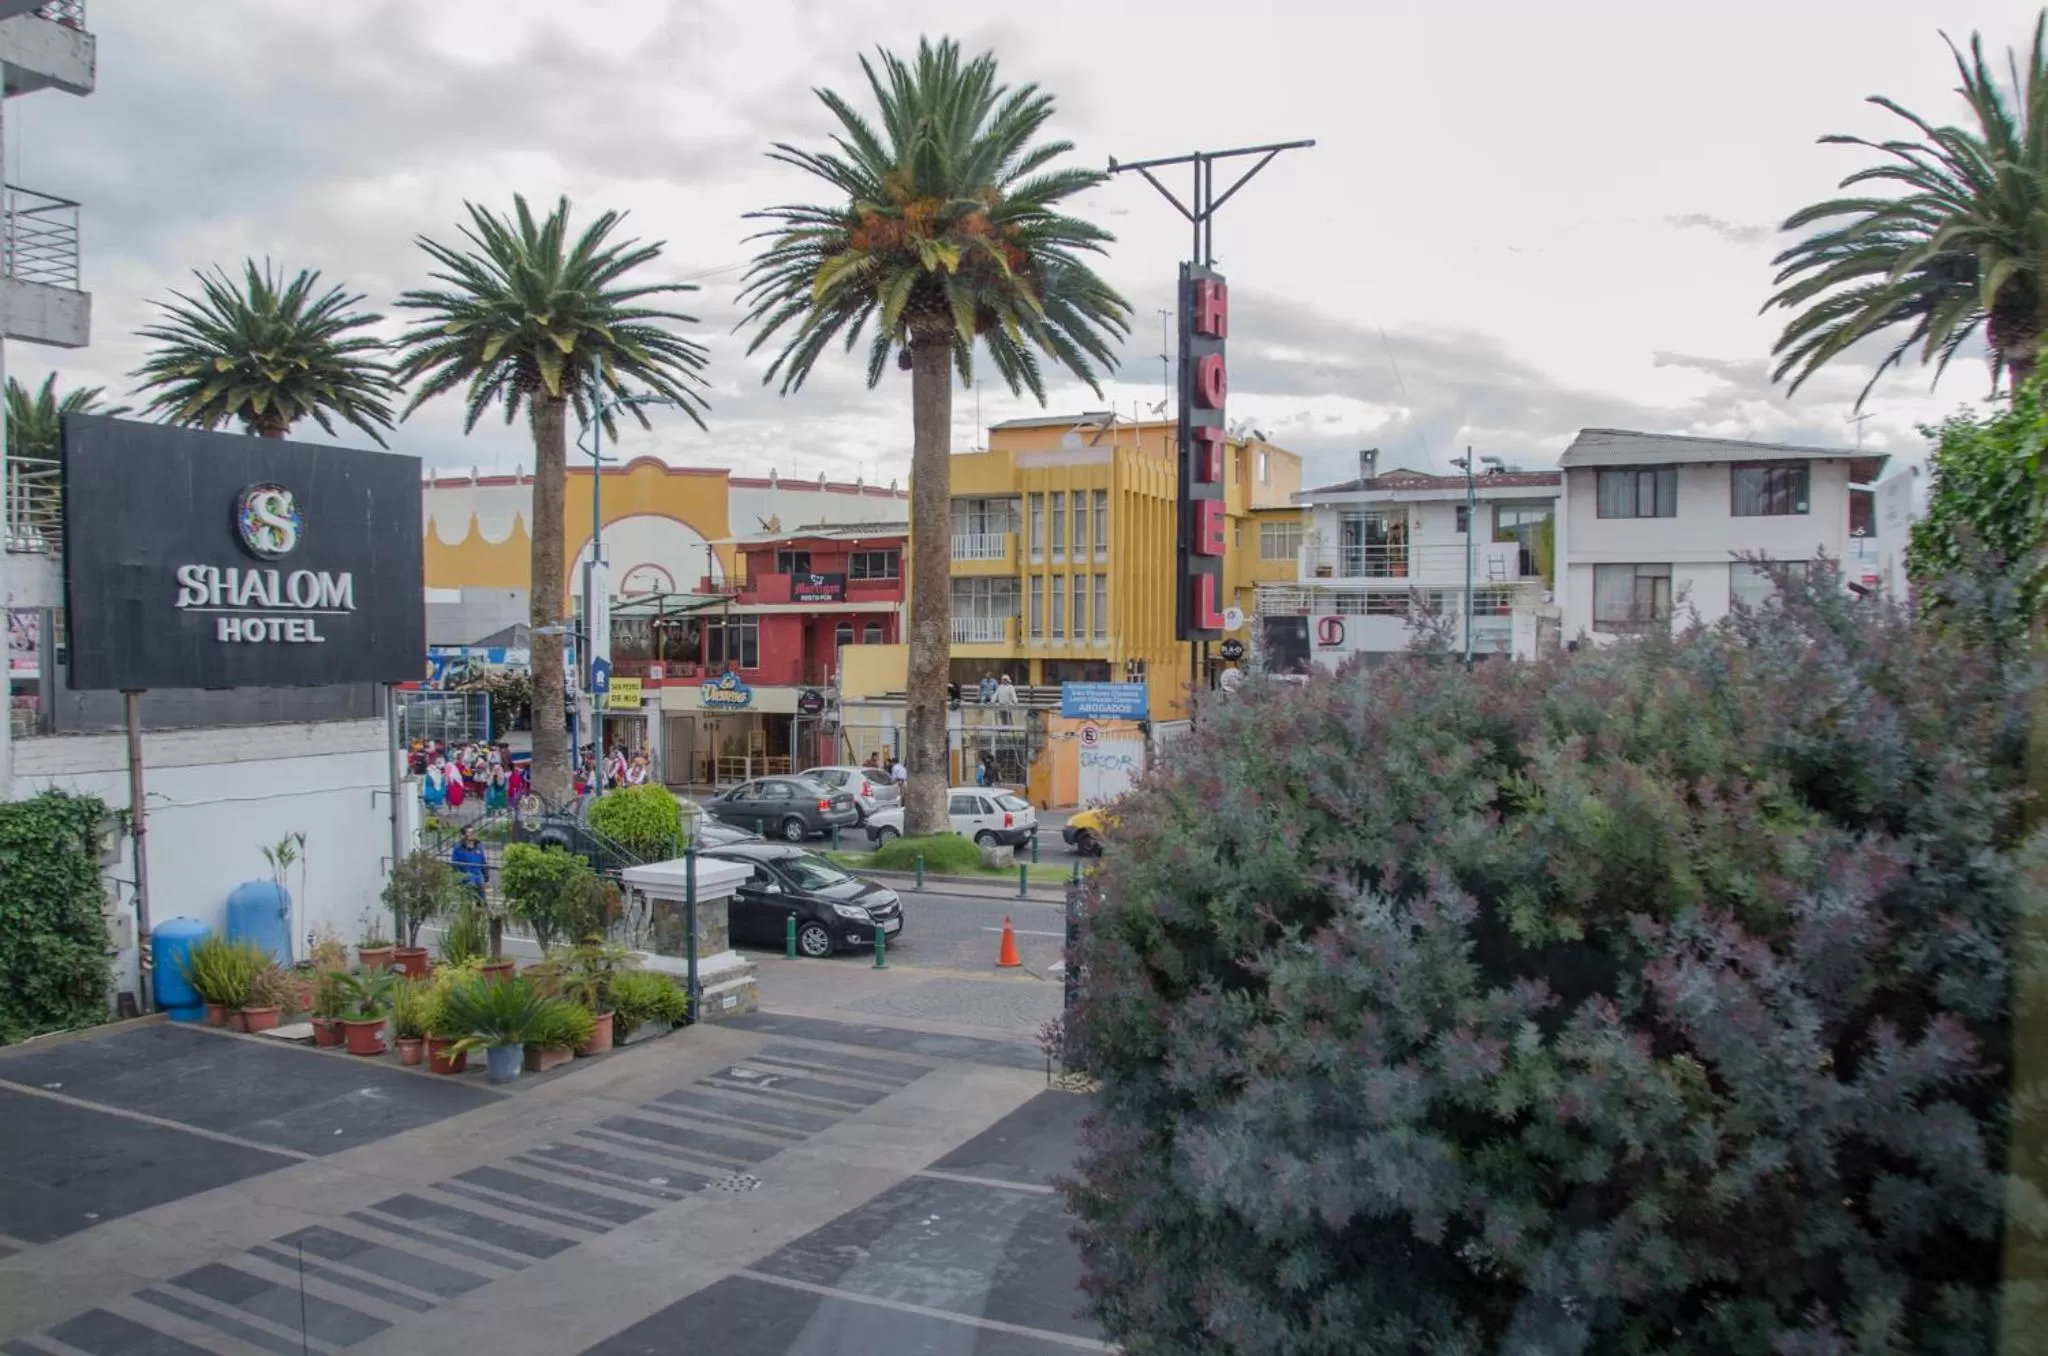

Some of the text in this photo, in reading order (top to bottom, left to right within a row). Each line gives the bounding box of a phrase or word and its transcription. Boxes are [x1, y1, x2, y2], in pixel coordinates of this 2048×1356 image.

[1195, 279, 1228, 630] HOTEL
[175, 564, 357, 609] SHALOM
[217, 617, 325, 642] HOTEL
